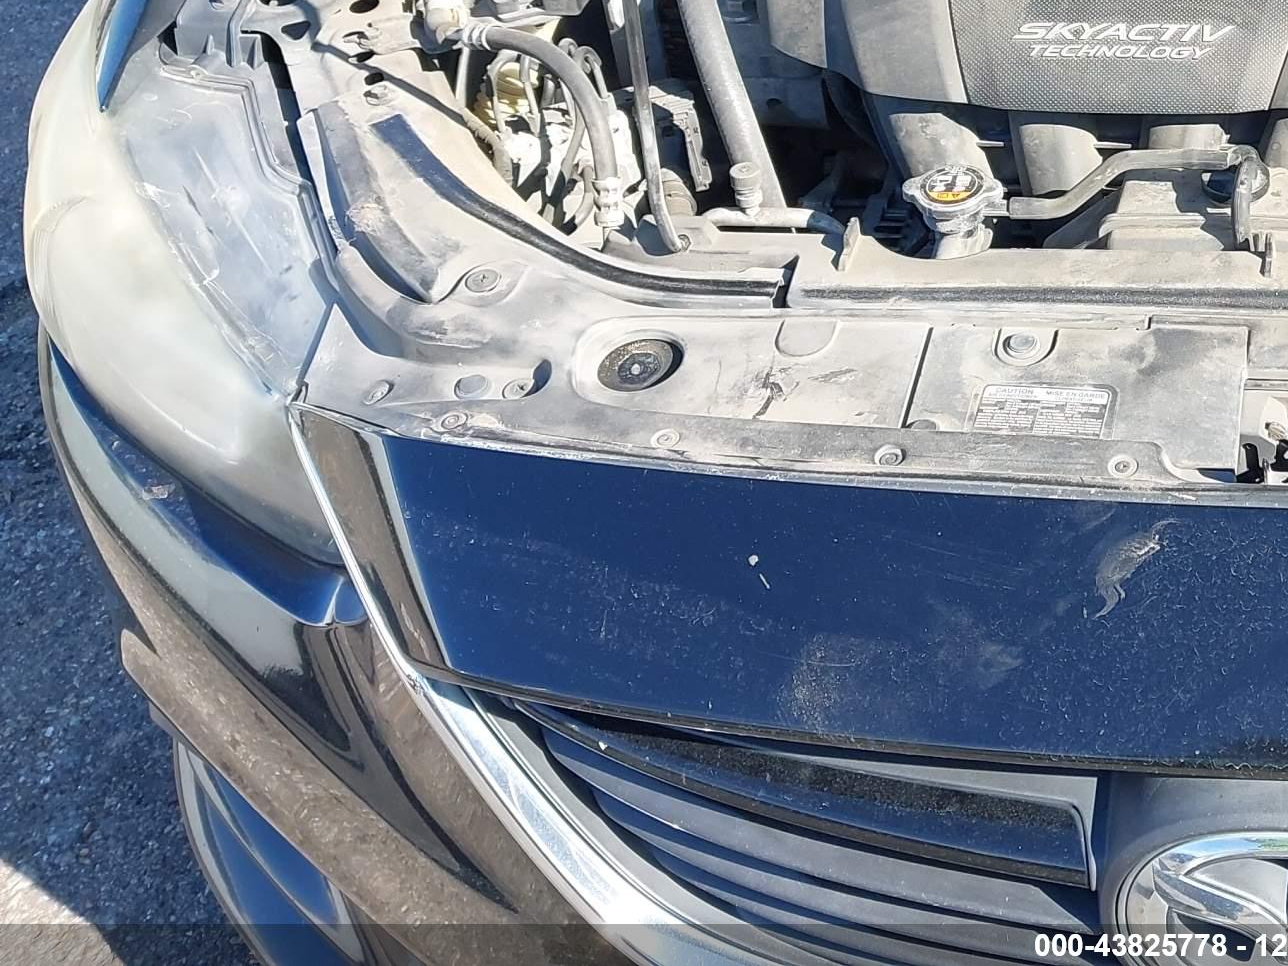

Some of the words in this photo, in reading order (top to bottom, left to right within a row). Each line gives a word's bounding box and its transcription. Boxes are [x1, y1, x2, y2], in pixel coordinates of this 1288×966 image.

[1011, 21, 1237, 43] SKYACTIV
[1028, 44, 1213, 60] TECHNOLOGY
[996, 387, 1034, 395] CAUTION
